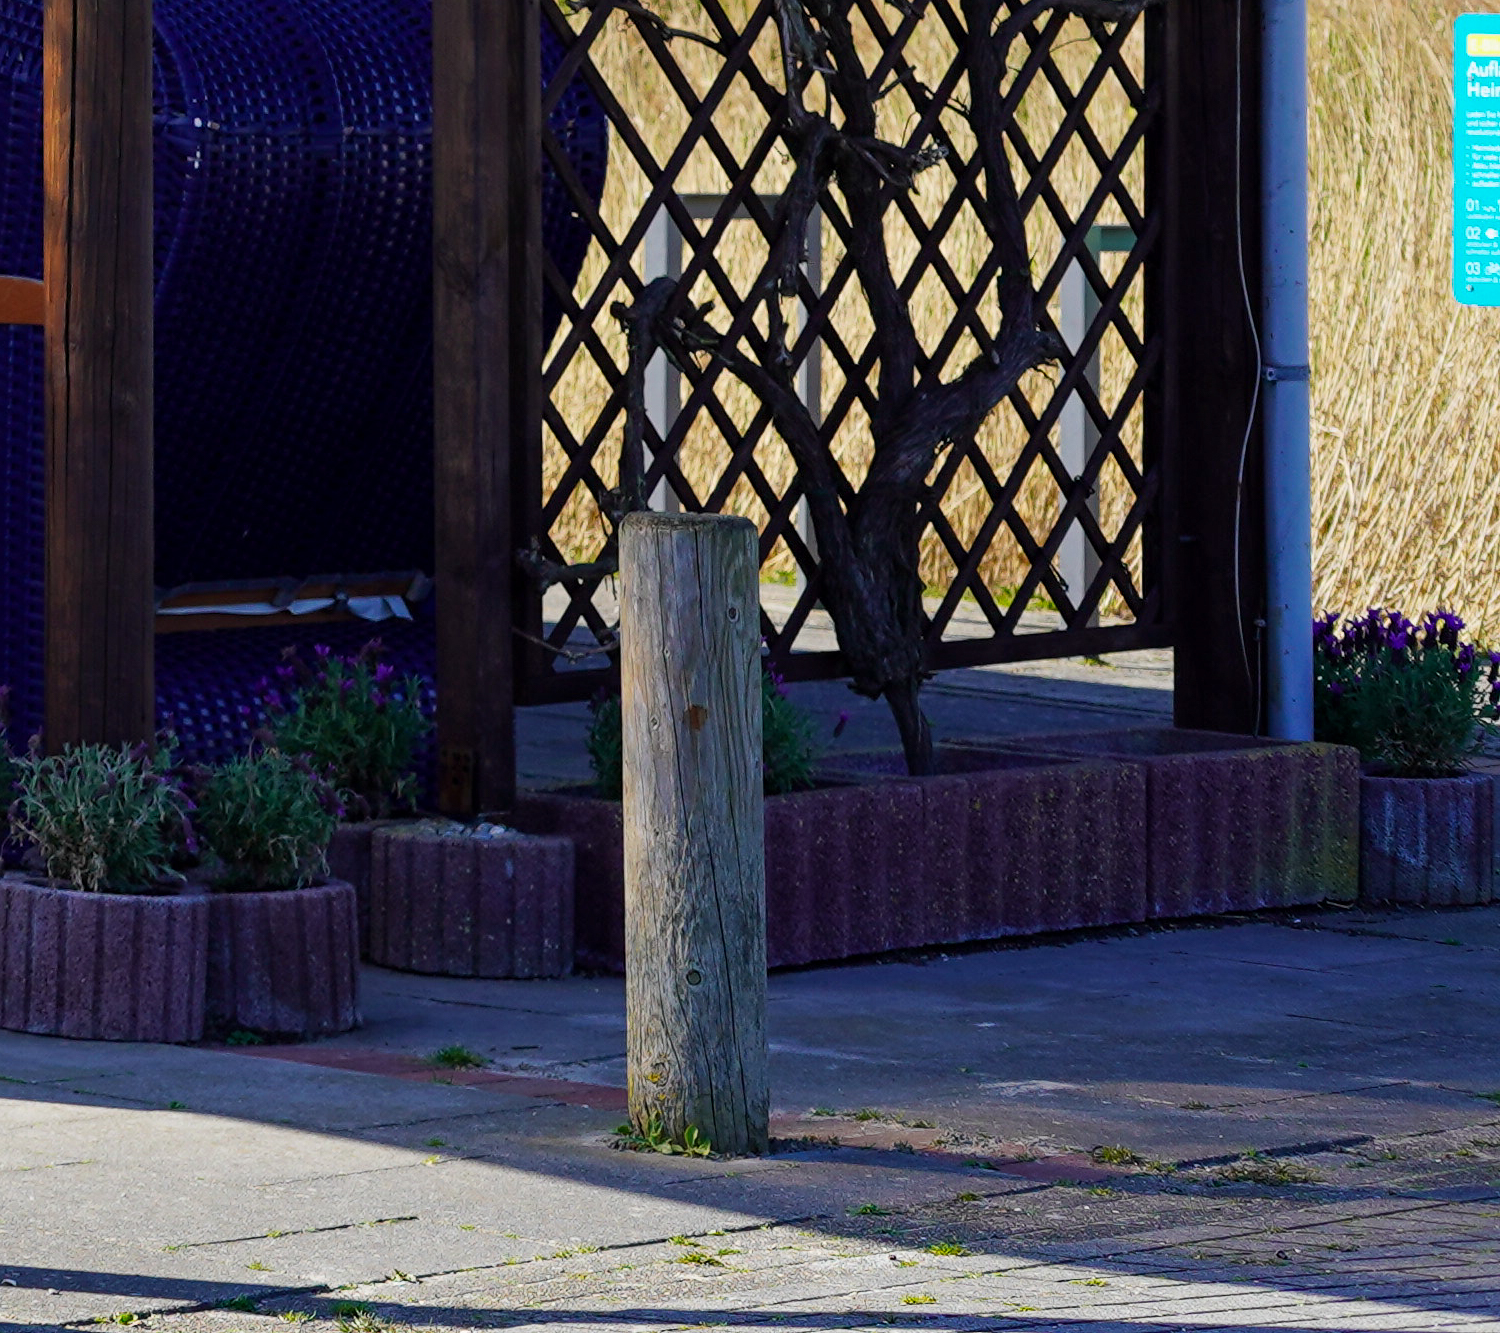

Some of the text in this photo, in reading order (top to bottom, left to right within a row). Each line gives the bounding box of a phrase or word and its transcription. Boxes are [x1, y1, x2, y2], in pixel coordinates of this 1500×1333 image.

[1466, 59, 1500, 78] Aufl
[1466, 226, 1481, 240] 02
[1466, 261, 1481, 276] 03
